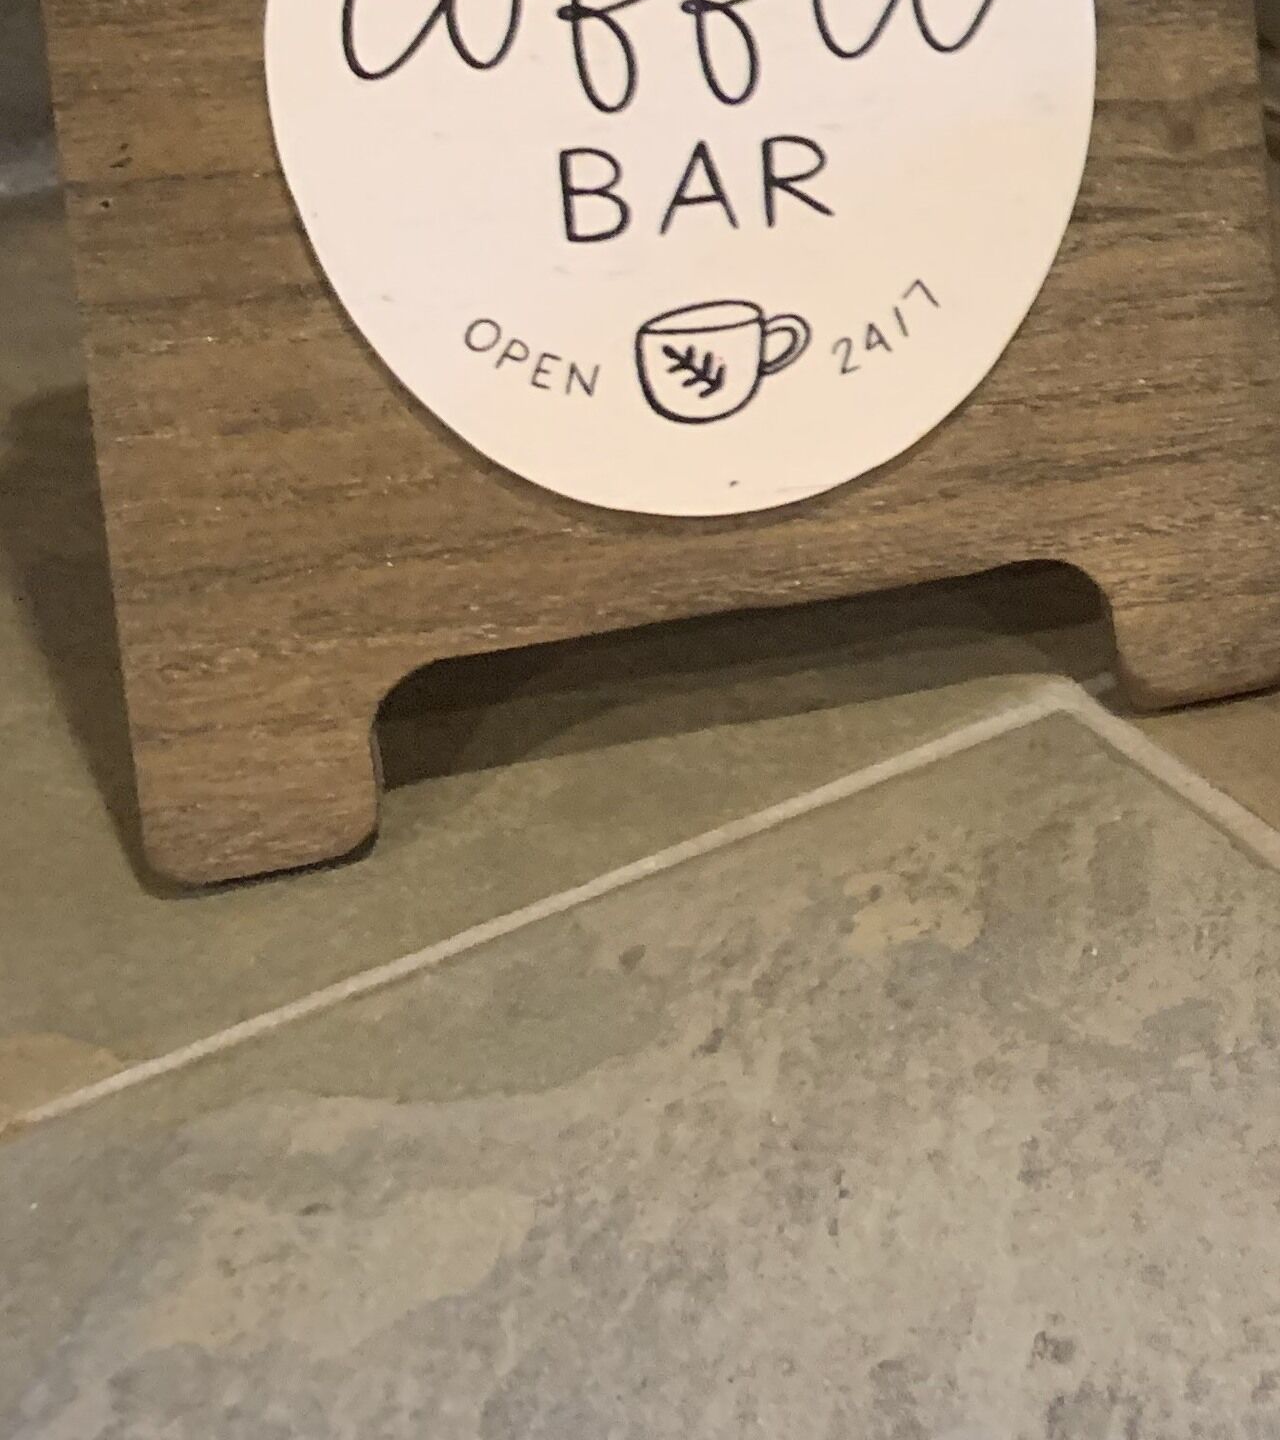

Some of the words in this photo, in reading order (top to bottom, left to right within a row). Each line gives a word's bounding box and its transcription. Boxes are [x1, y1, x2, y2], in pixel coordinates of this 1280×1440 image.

[558, 134, 836, 245] BAR
[462, 316, 603, 399] OPEN
[830, 277, 944, 378] 24/7
